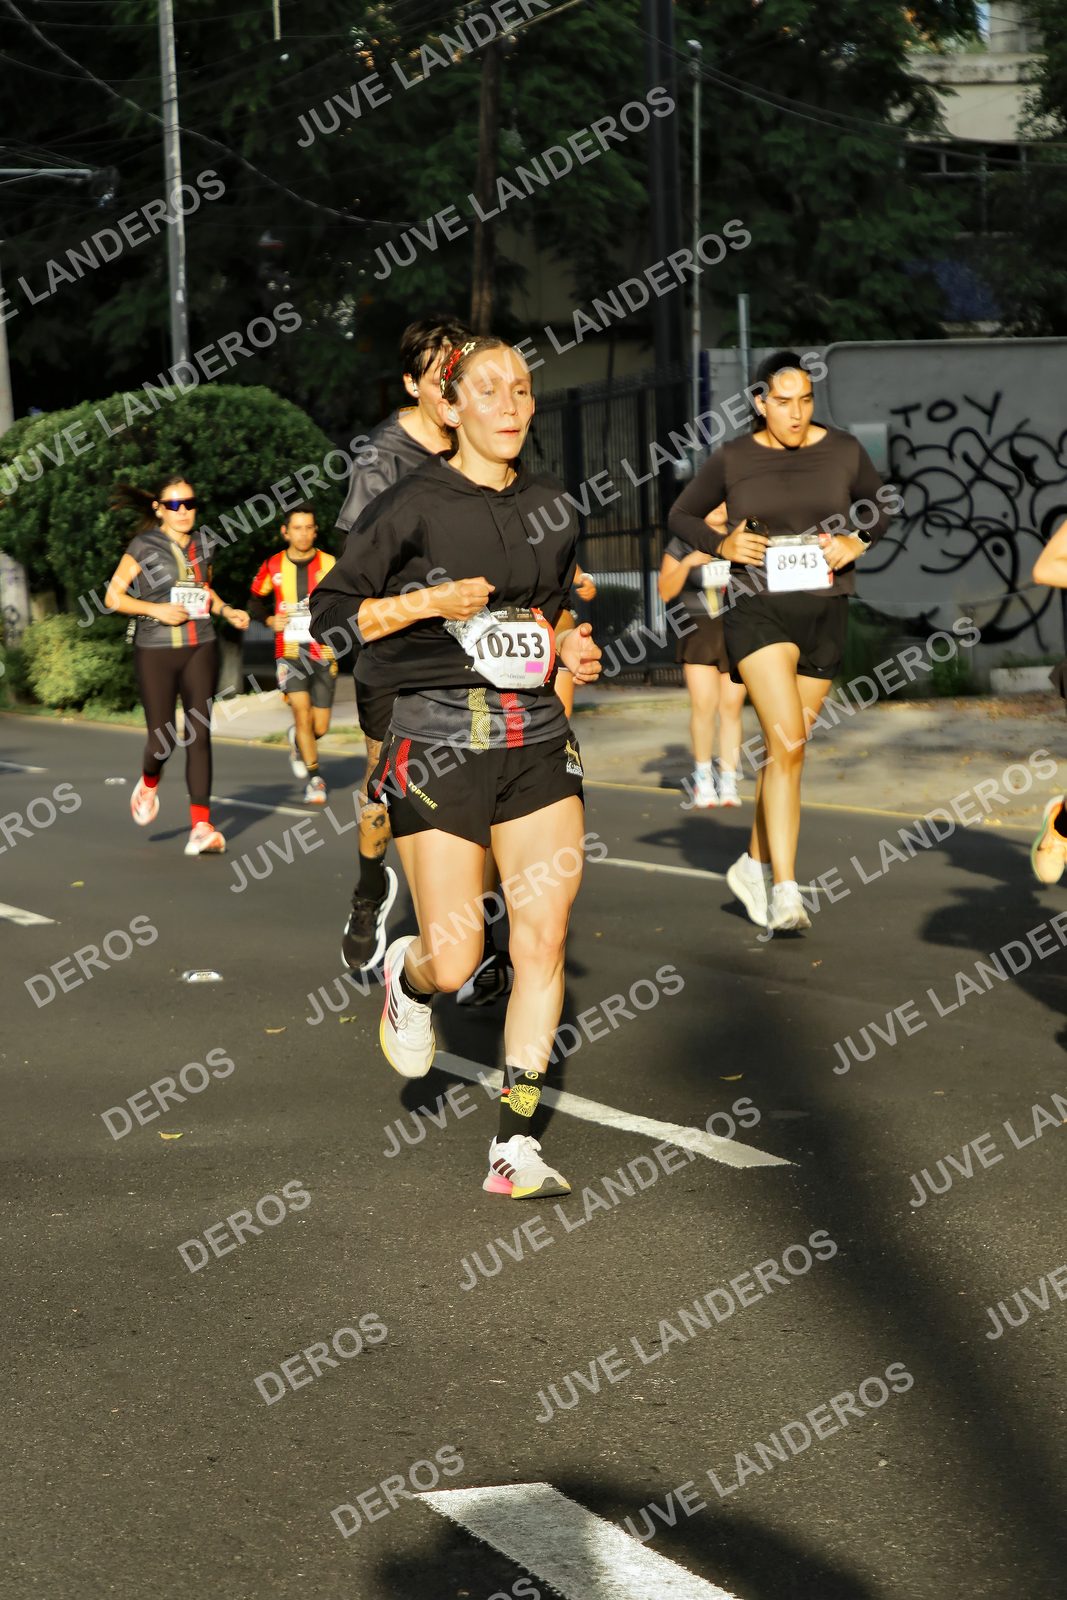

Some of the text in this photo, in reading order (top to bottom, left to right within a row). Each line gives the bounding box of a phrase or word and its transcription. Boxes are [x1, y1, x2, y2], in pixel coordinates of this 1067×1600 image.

[890, 390, 1002, 435] TOY
[777, 552, 818, 570] 8943
[476, 632, 545, 660] 10253
[408, 780, 438, 810] TOPTIME
